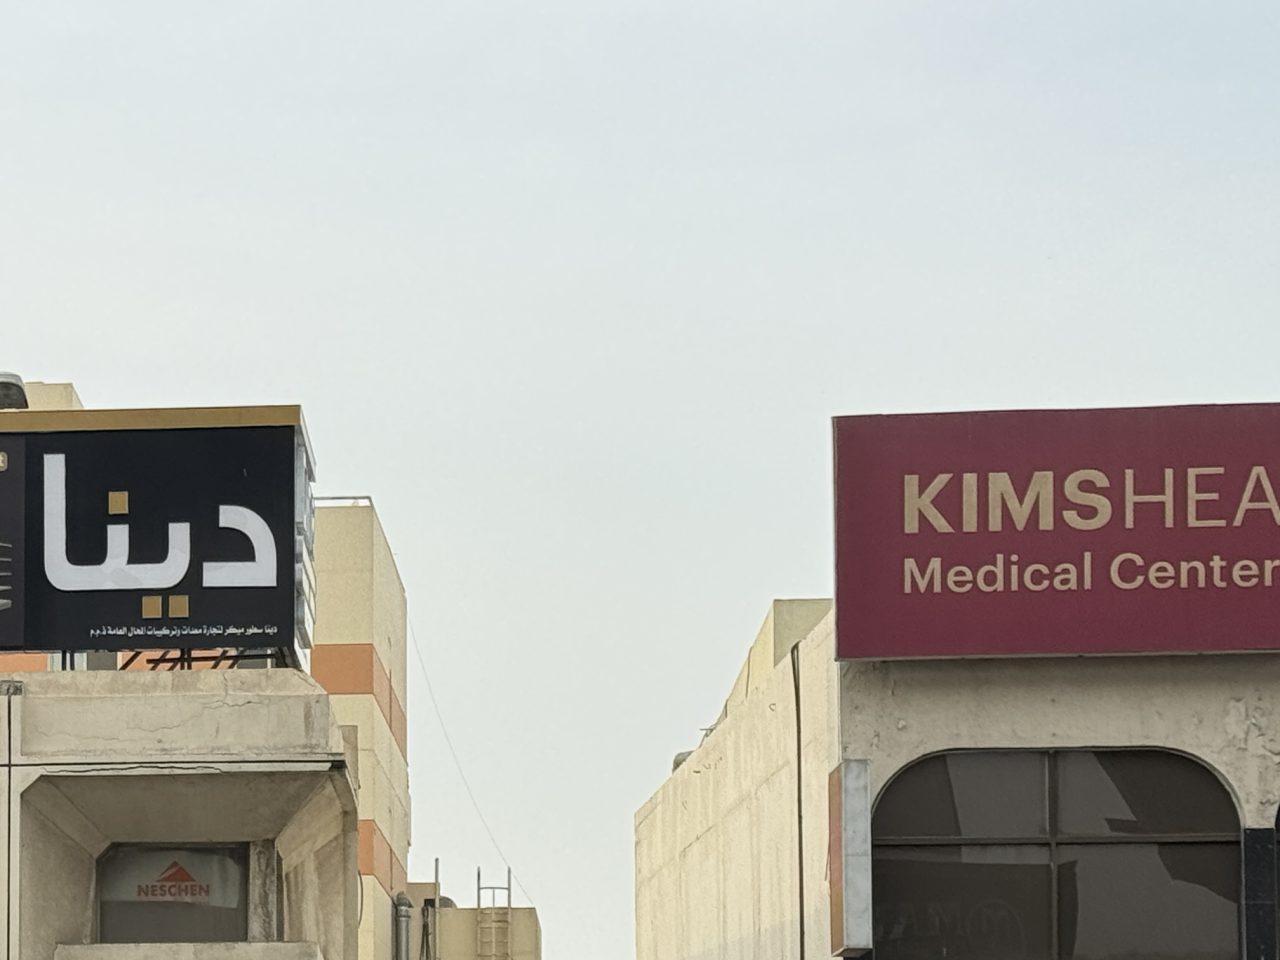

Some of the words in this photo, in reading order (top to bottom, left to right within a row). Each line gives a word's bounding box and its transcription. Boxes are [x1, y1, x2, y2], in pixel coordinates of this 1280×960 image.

[903, 465, 1280, 534] KIMSHEA
[43, 453, 278, 619] دينا
[903, 551, 1092, 594] Medical
[1110, 550, 1280, 590] Center
[137, 884, 210, 897] NESCHEN
